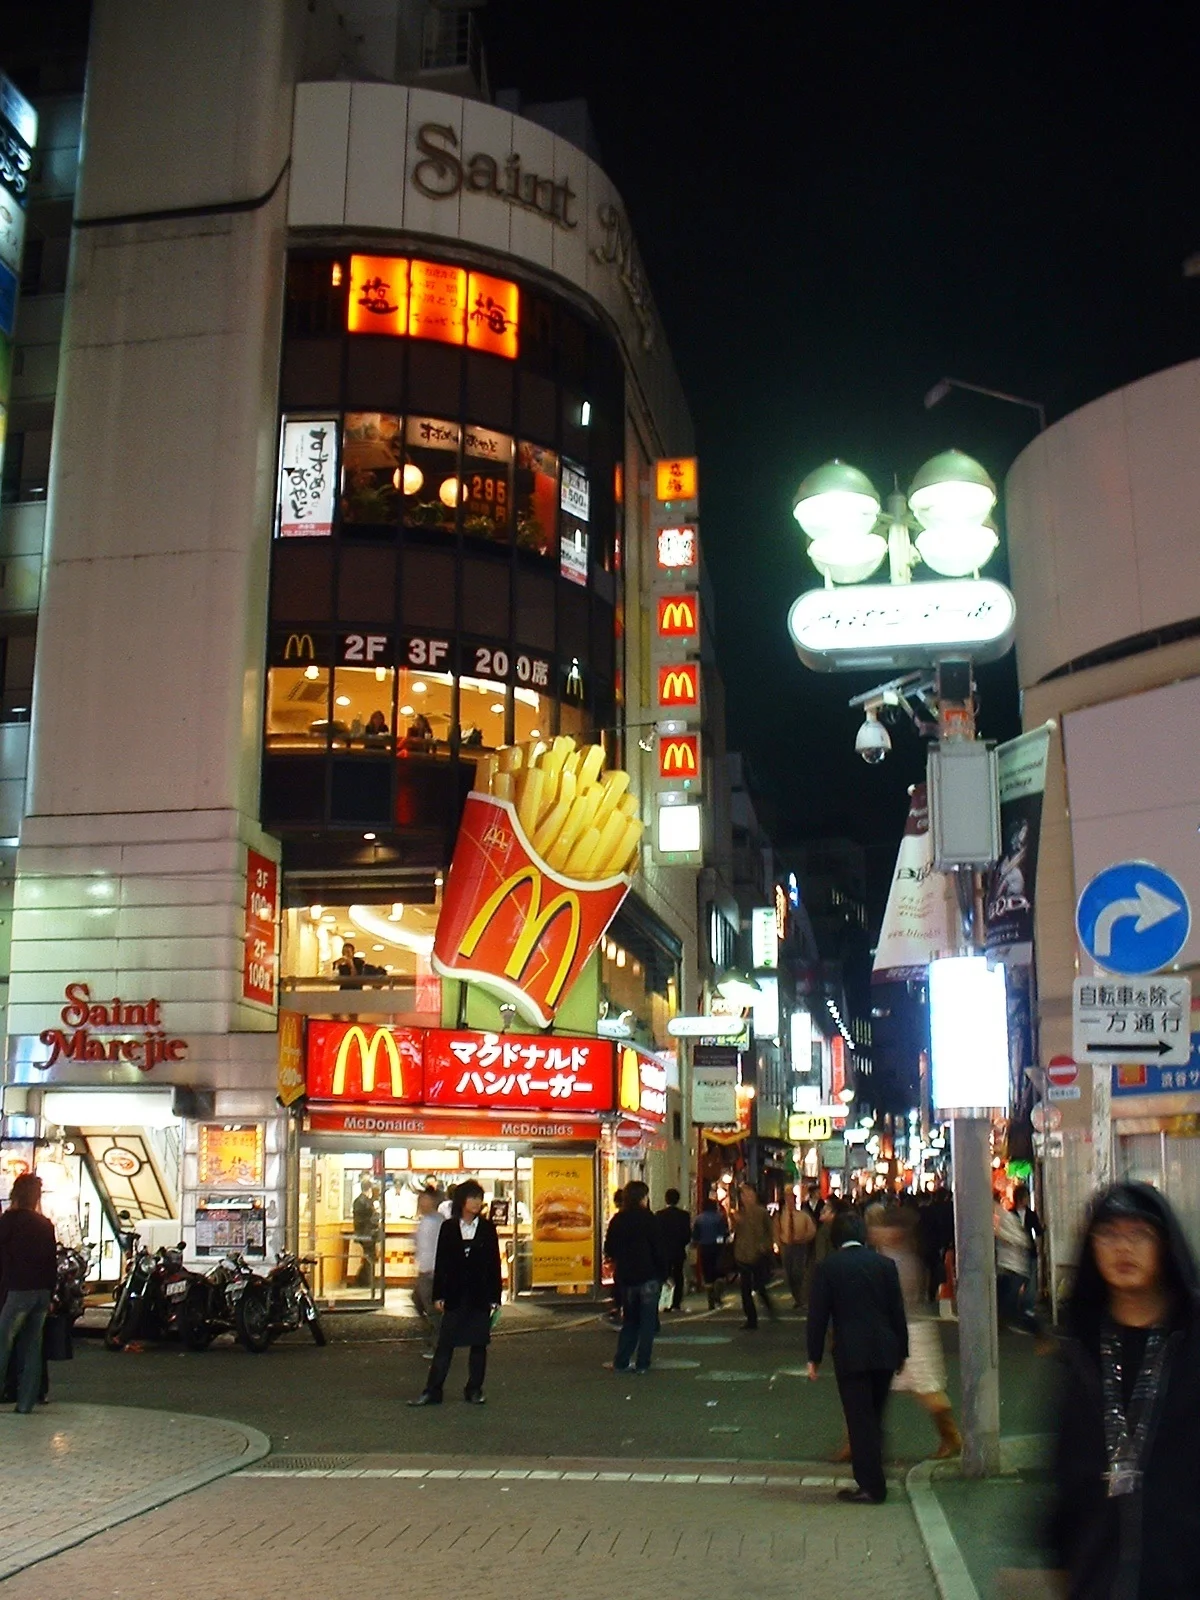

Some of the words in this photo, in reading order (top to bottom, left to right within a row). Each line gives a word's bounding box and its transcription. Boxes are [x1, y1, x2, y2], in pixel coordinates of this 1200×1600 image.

[412, 122, 578, 230] Saint
[344, 635, 388, 661] 2F
[408, 639, 449, 667] 3F
[61, 982, 161, 1028] Saint
[1080, 984, 1182, 1008] 自転車を除く
[1080, 1011, 1182, 1033] 一方通行
[450, 1041, 589, 1072] マクドナルド
[455, 1068, 593, 1098] ハンバーガー
[343, 1116, 425, 1132] McDonald's
[501, 1122, 574, 1136] McDonald's
